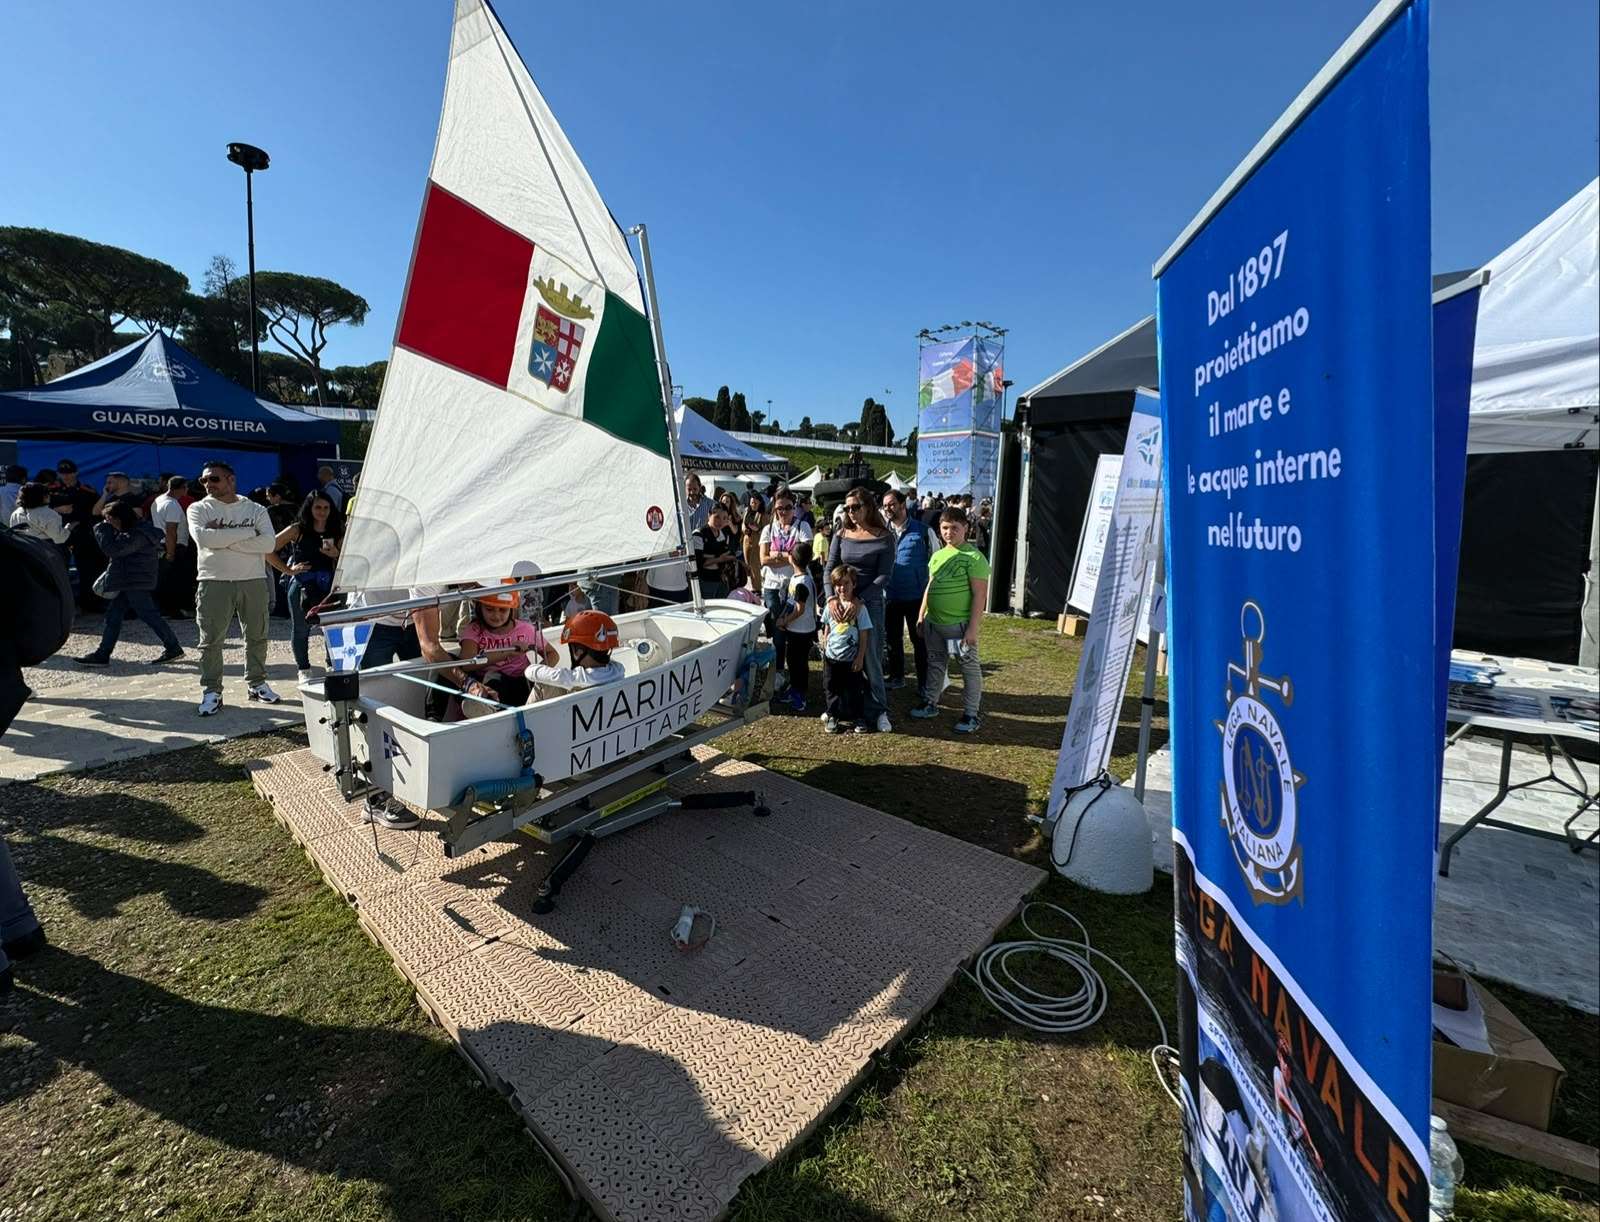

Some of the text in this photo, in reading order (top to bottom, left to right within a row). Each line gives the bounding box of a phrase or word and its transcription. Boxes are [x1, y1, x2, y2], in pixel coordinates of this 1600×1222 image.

[1207, 229, 1289, 327] Dal 1897
[1195, 307, 1310, 397] proiettiamo
[92, 410, 267, 433] GUARDIA COSTIERA
[1209, 387, 1291, 437] il mare e
[1187, 447, 1342, 500] le acque interne
[1207, 511, 1302, 552] nel futuro
[570, 693, 703, 776] MILITARE
[571, 658, 704, 741] MARINA
[1226, 705, 1243, 749] LEGA
[1247, 703, 1292, 793] NAVALE
[1232, 806, 1284, 863] ITALIANA
[1252, 953, 1417, 1222] NAVALE
